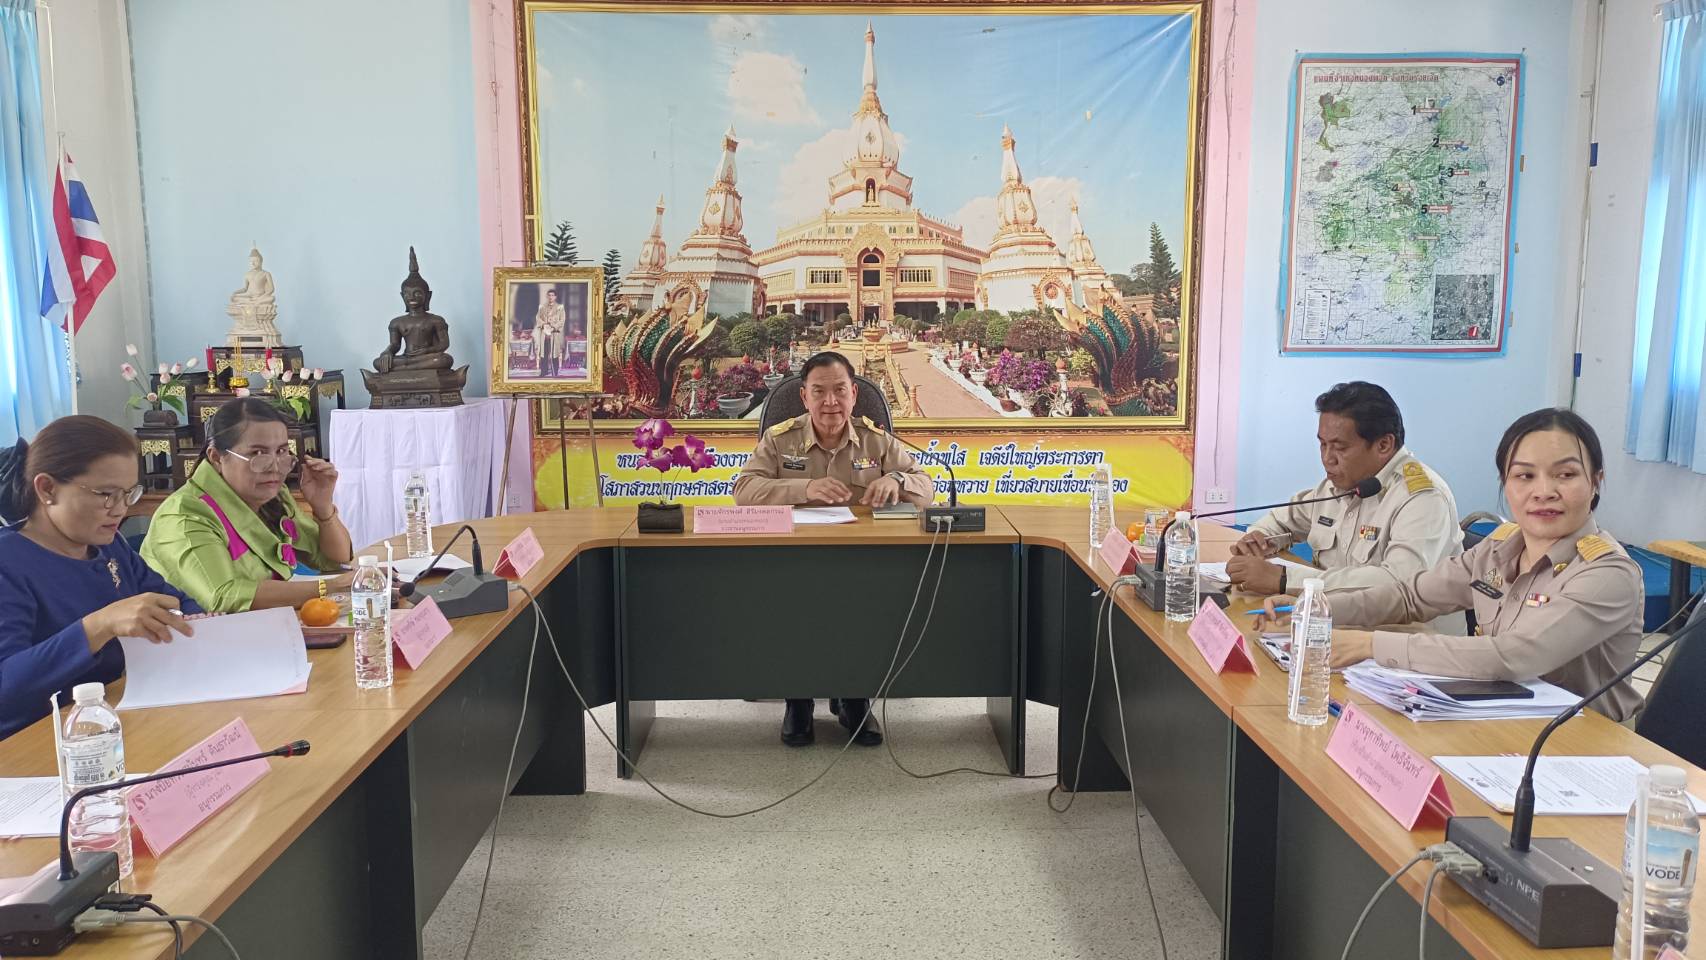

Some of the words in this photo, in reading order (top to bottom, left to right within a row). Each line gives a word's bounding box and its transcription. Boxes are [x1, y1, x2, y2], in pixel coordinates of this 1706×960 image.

[1411, 105, 1417, 115] 1
[1432, 138, 1440, 148] 2
[1447, 167, 1454, 177] 3
[1420, 204, 1428, 214] 5
[979, 444, 1104, 469] เจดีย์ใหญ่ตระการตา
[1645, 866, 1681, 880] VODE
